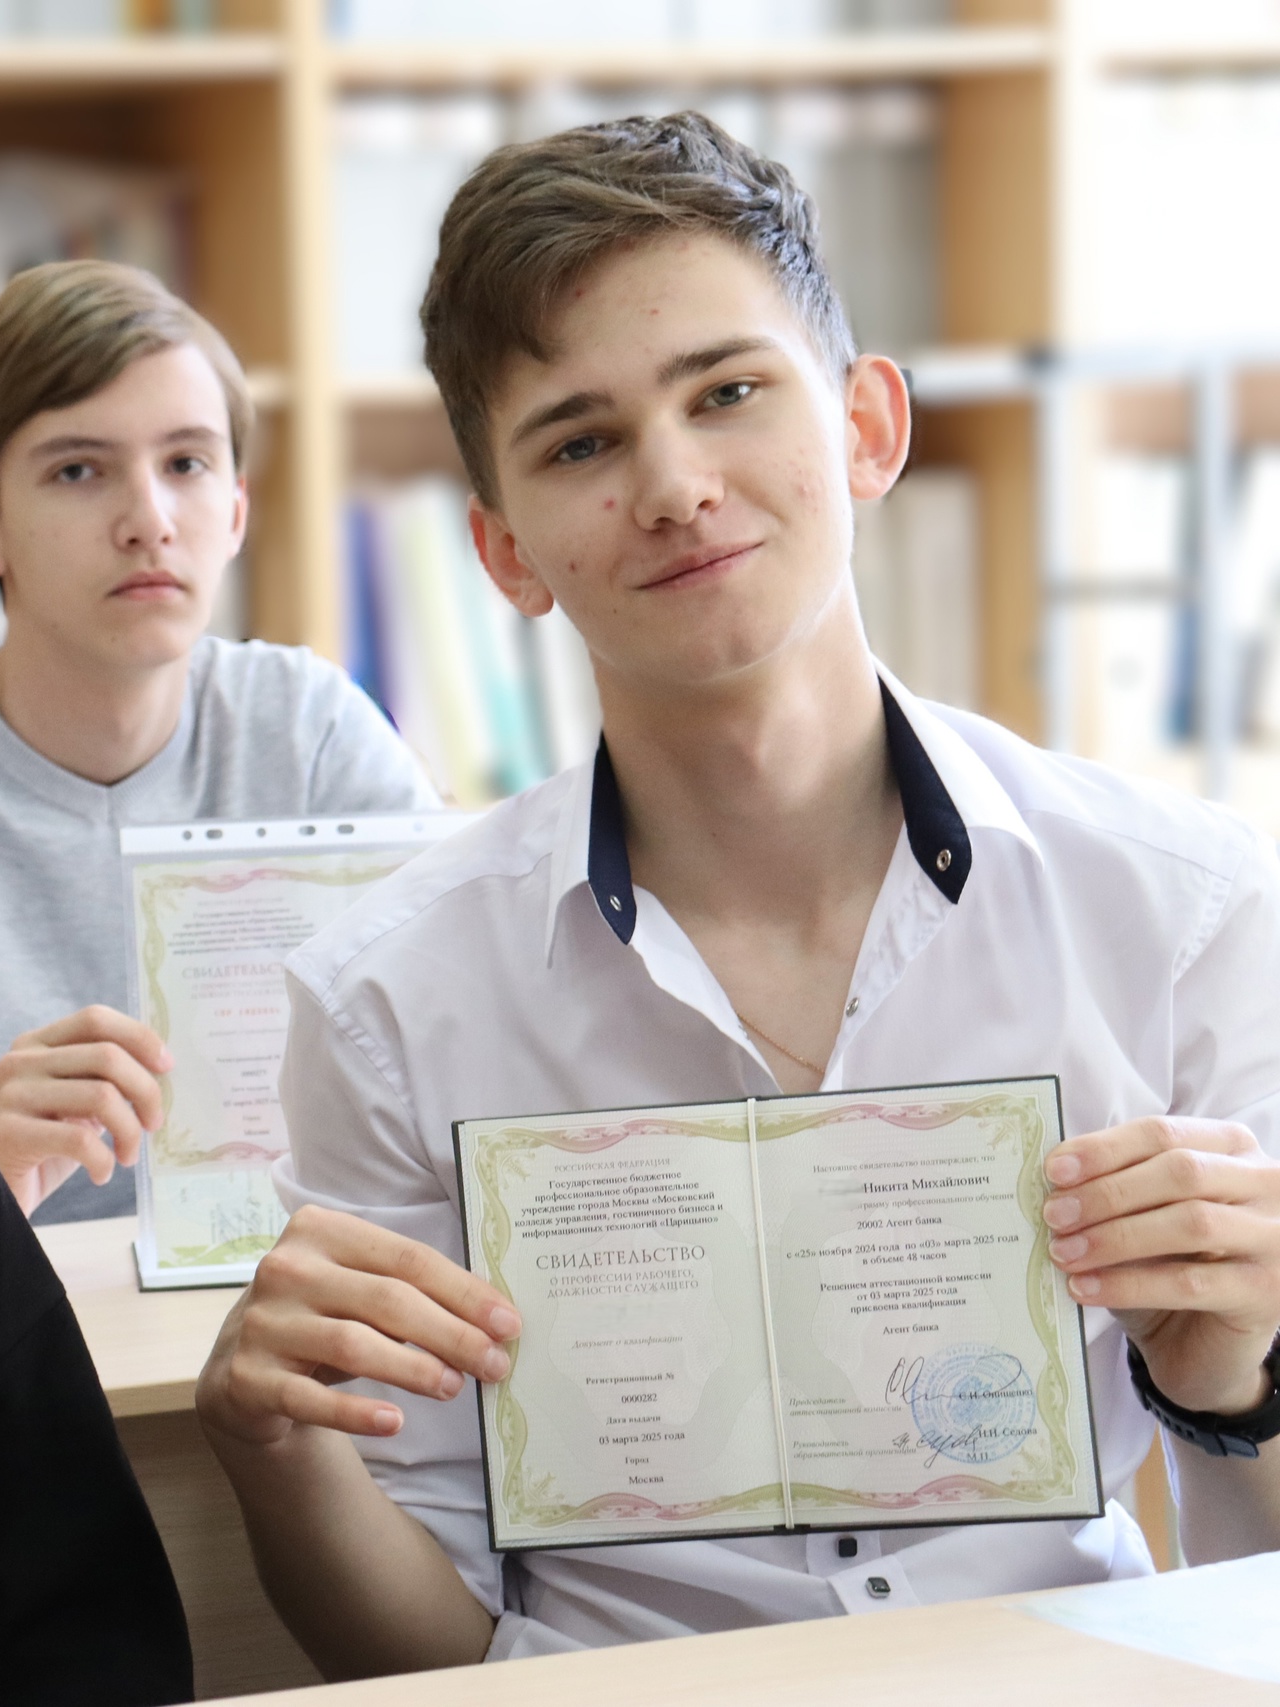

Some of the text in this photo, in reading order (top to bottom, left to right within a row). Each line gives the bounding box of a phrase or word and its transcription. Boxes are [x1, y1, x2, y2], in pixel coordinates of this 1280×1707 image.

[181, 961, 286, 979] СВИДЕТЕЛЬСТ
[553, 1157, 670, 1173] РОССИЙСКАЯ ФЕДЕРАЦИЯ
[548, 1172, 681, 1190] Государственное бюджетное
[863, 1175, 990, 1194] Никита Михайлович
[534, 1182, 699, 1203] профессиональное образовательное
[975, 1193, 1014, 1203] обучения
[521, 1190, 715, 1217] учреждение города Москвы «Московский
[514, 1218, 553, 1227] колледж
[555, 1213, 610, 1226] управления,
[612, 1208, 676, 1219] гостиничного
[678, 1205, 715, 1214] бизнеса
[856, 1216, 942, 1230] 20002 Агент банка
[521, 1216, 719, 1240] информационных технологий «Царицыно»
[794, 1248, 816, 1258] «25»
[818, 1246, 852, 1257] ноября
[854, 1243, 875, 1254] 2024
[878, 1244, 899, 1252] года
[904, 1242, 916, 1250] по
[919, 1238, 941, 1249] «03»
[943, 1238, 970, 1248] марта
[972, 1234, 994, 1245] 2025
[997, 1234, 1018, 1243] года
[535, 1244, 705, 1270] СВИДЕТЕЛЬСТВО
[870, 1254, 904, 1264] объеме
[906, 1252, 917, 1262] 48
[919, 1252, 946, 1261] часов
[561, 1272, 632, 1286] ПРОФЕССИИ
[635, 1269, 694, 1281] РАБОЧЕГО,
[819, 1272, 991, 1292] Решением аттестационной комиссии
[546, 1280, 699, 1299] ДОЛЖНОСТИ СЛУЖАЩЕГО
[869, 1290, 880, 1300] 03
[883, 1290, 910, 1301] марта
[912, 1286, 934, 1297] 2025
[936, 1287, 957, 1295] года
[850, 1297, 966, 1315] присвоена квалификация
[882, 1323, 939, 1335] Агент банка
[585, 1372, 662, 1385] Регистрационный
[621, 1393, 657, 1404] 0000282
[605, 1415, 661, 1426] Дата выдачи
[598, 1432, 685, 1445] 03 марта 2025 года
[1002, 1427, 1038, 1438] Седова
[624, 1456, 649, 1466] Город
[628, 1476, 664, 1485] Москва
